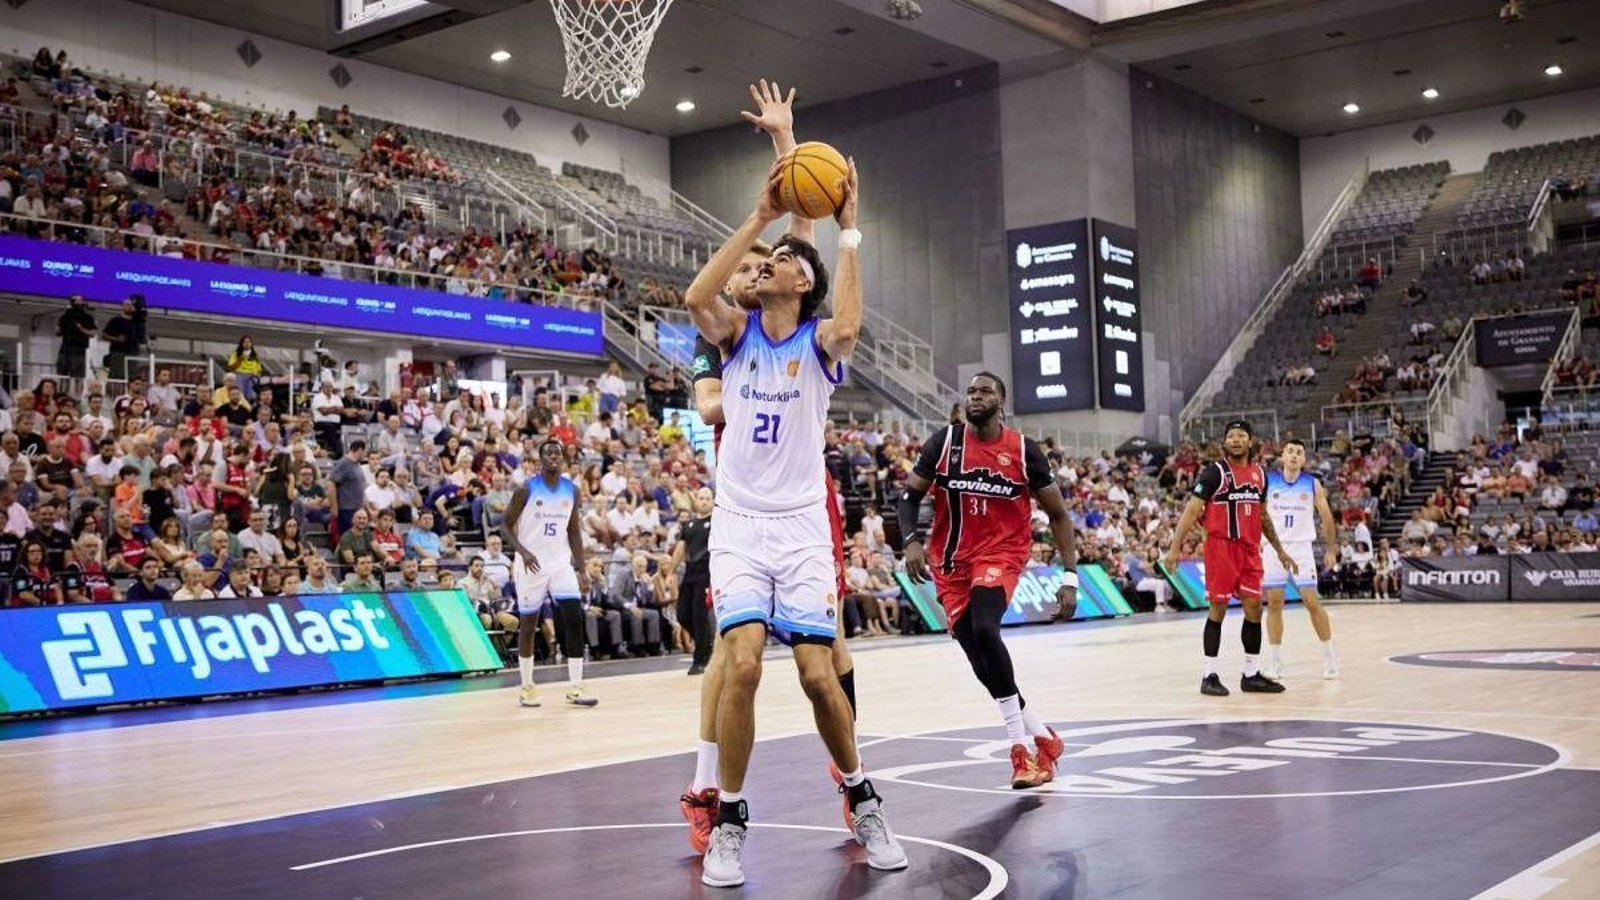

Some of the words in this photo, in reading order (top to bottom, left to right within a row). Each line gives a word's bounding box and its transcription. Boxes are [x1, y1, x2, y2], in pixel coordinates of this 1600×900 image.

[752, 412, 781, 444] 21
[947, 479, 1014, 495] COVIRAN
[969, 497, 988, 516] 31
[543, 522, 558, 537] 15
[1284, 515, 1294, 528] 11
[121, 599, 390, 680] Fijaplast
